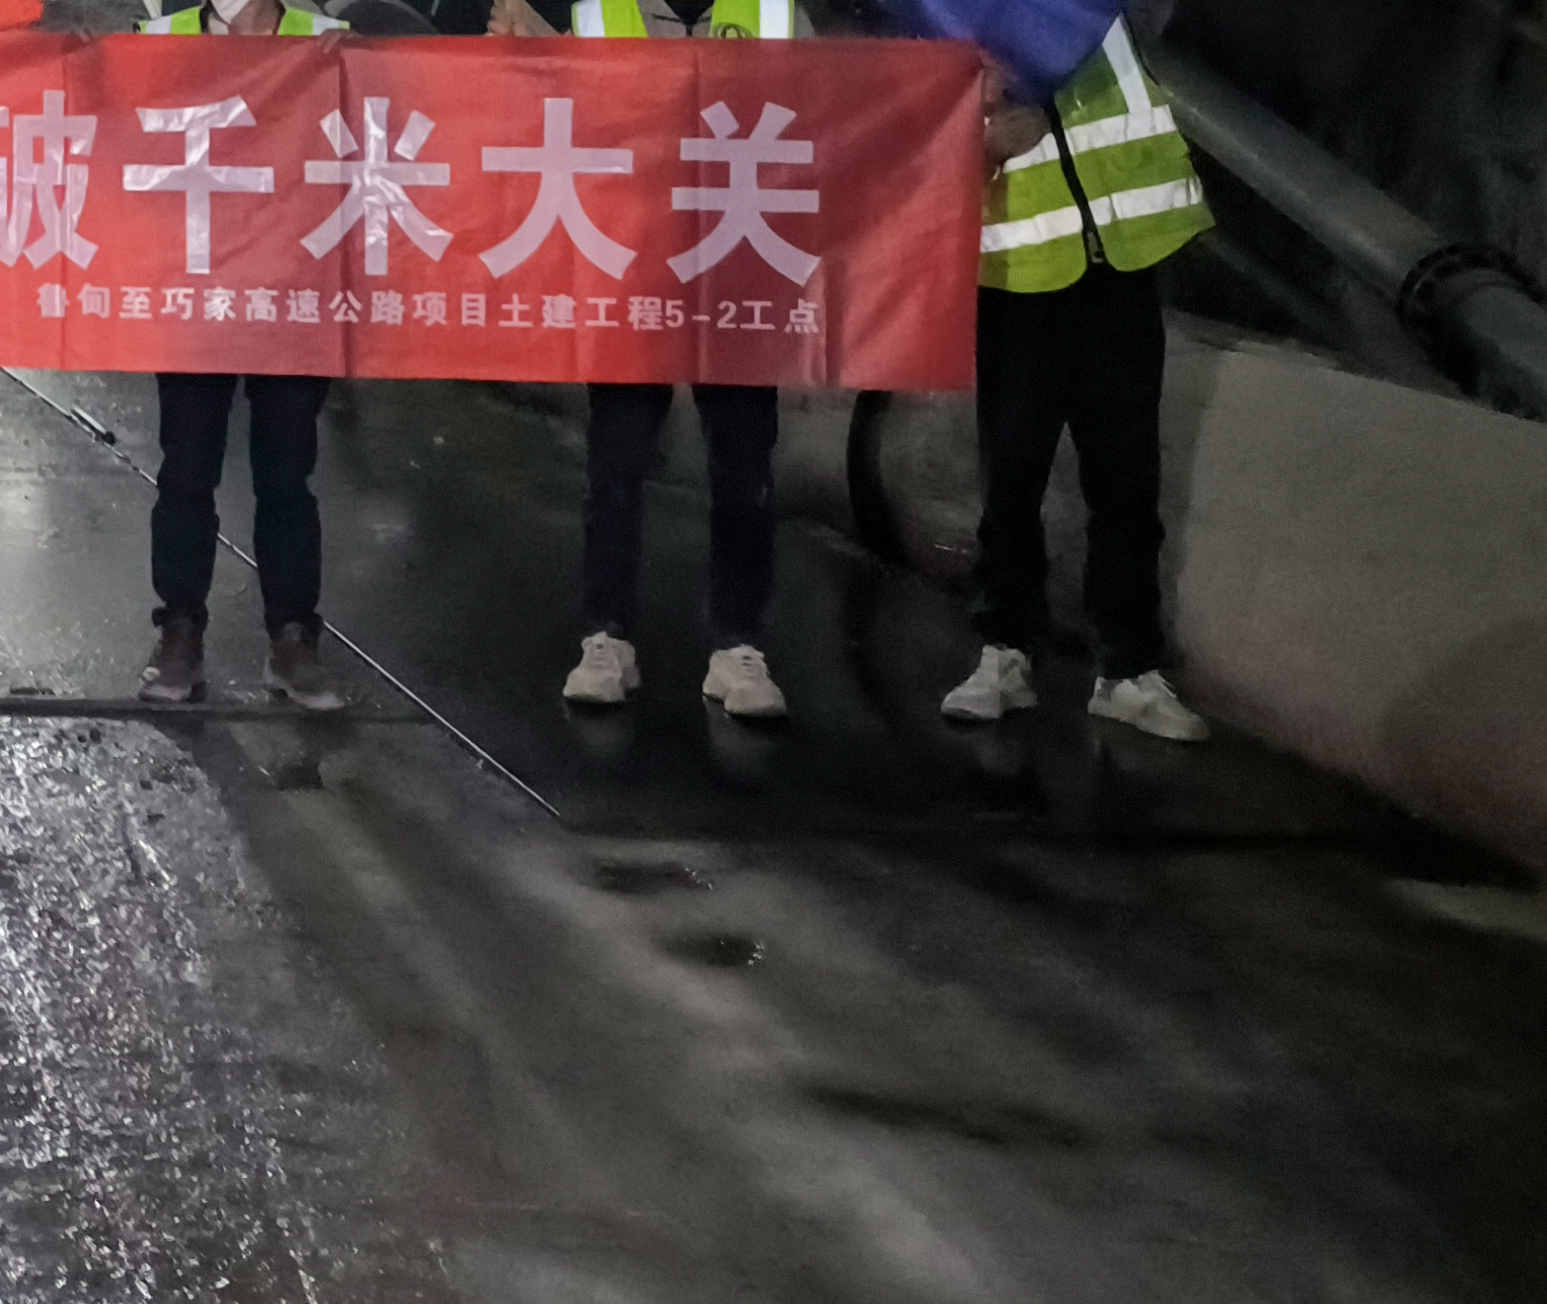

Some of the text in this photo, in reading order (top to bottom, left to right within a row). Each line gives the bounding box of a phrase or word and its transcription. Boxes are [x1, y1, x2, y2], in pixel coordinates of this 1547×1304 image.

[37, 283, 820, 333] 鲁甸至巧家高速公路项目土建工程5-2工点
